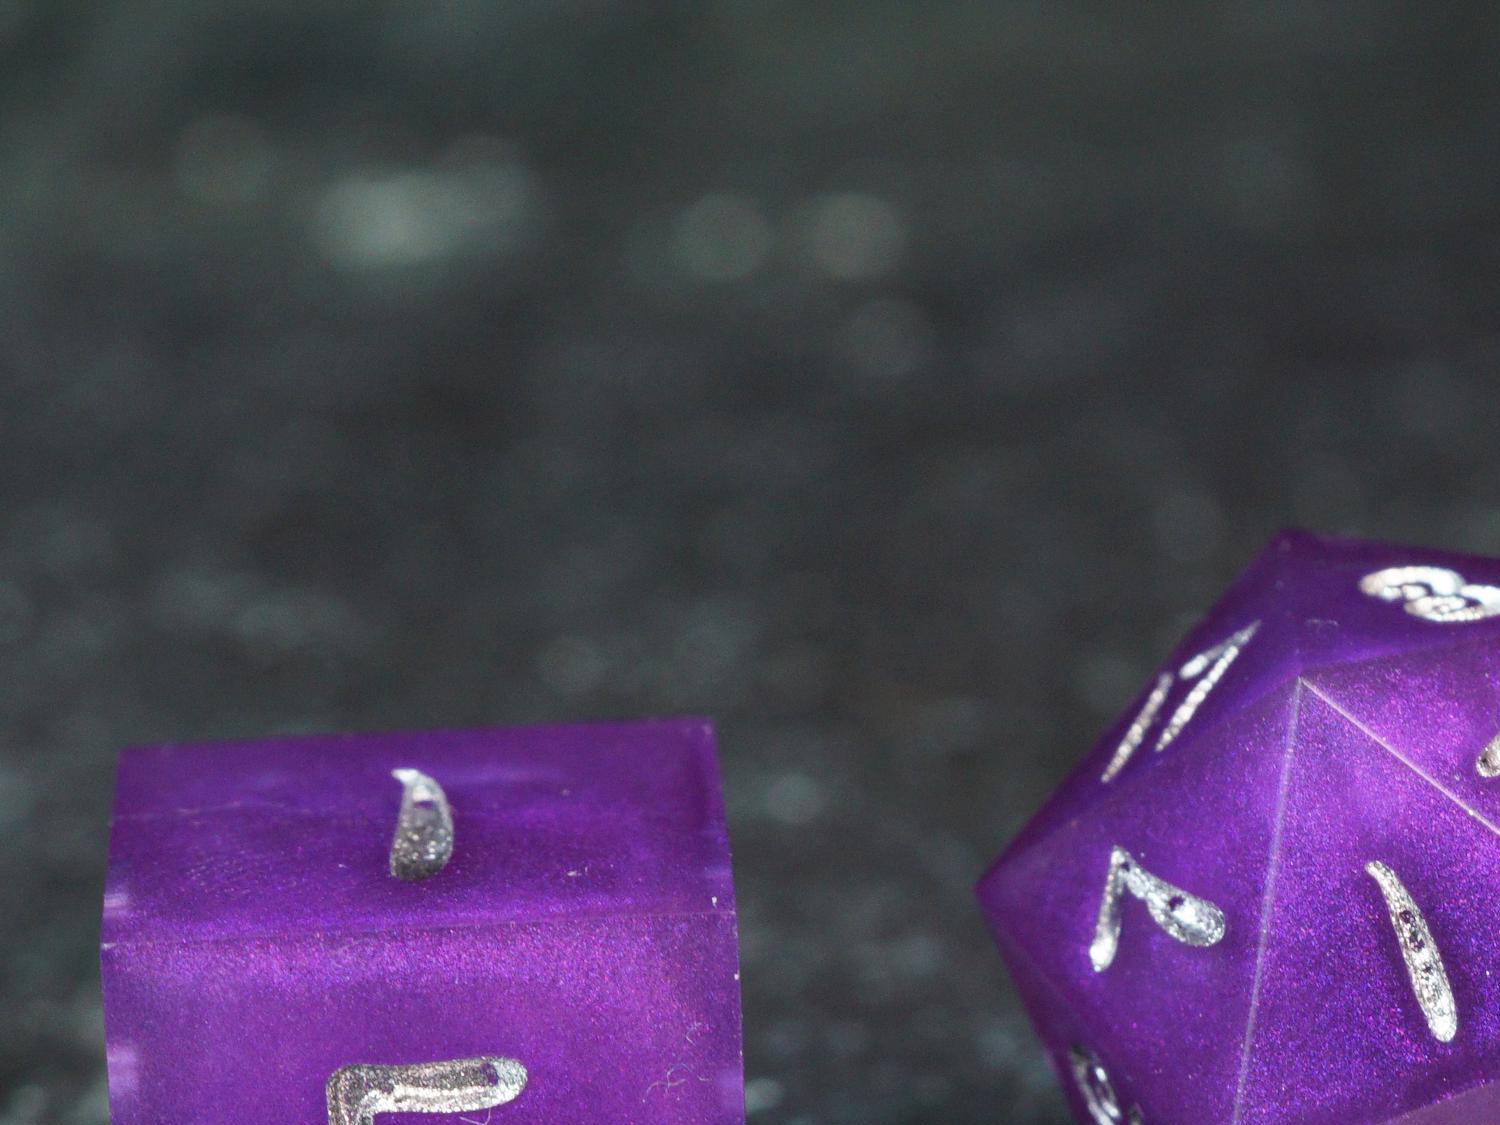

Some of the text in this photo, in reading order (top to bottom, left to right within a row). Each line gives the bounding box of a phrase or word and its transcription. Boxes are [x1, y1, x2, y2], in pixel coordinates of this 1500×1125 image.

[390, 768, 454, 880] 1
[1089, 844, 1226, 972] 7
[1365, 859, 1458, 1043] 1
